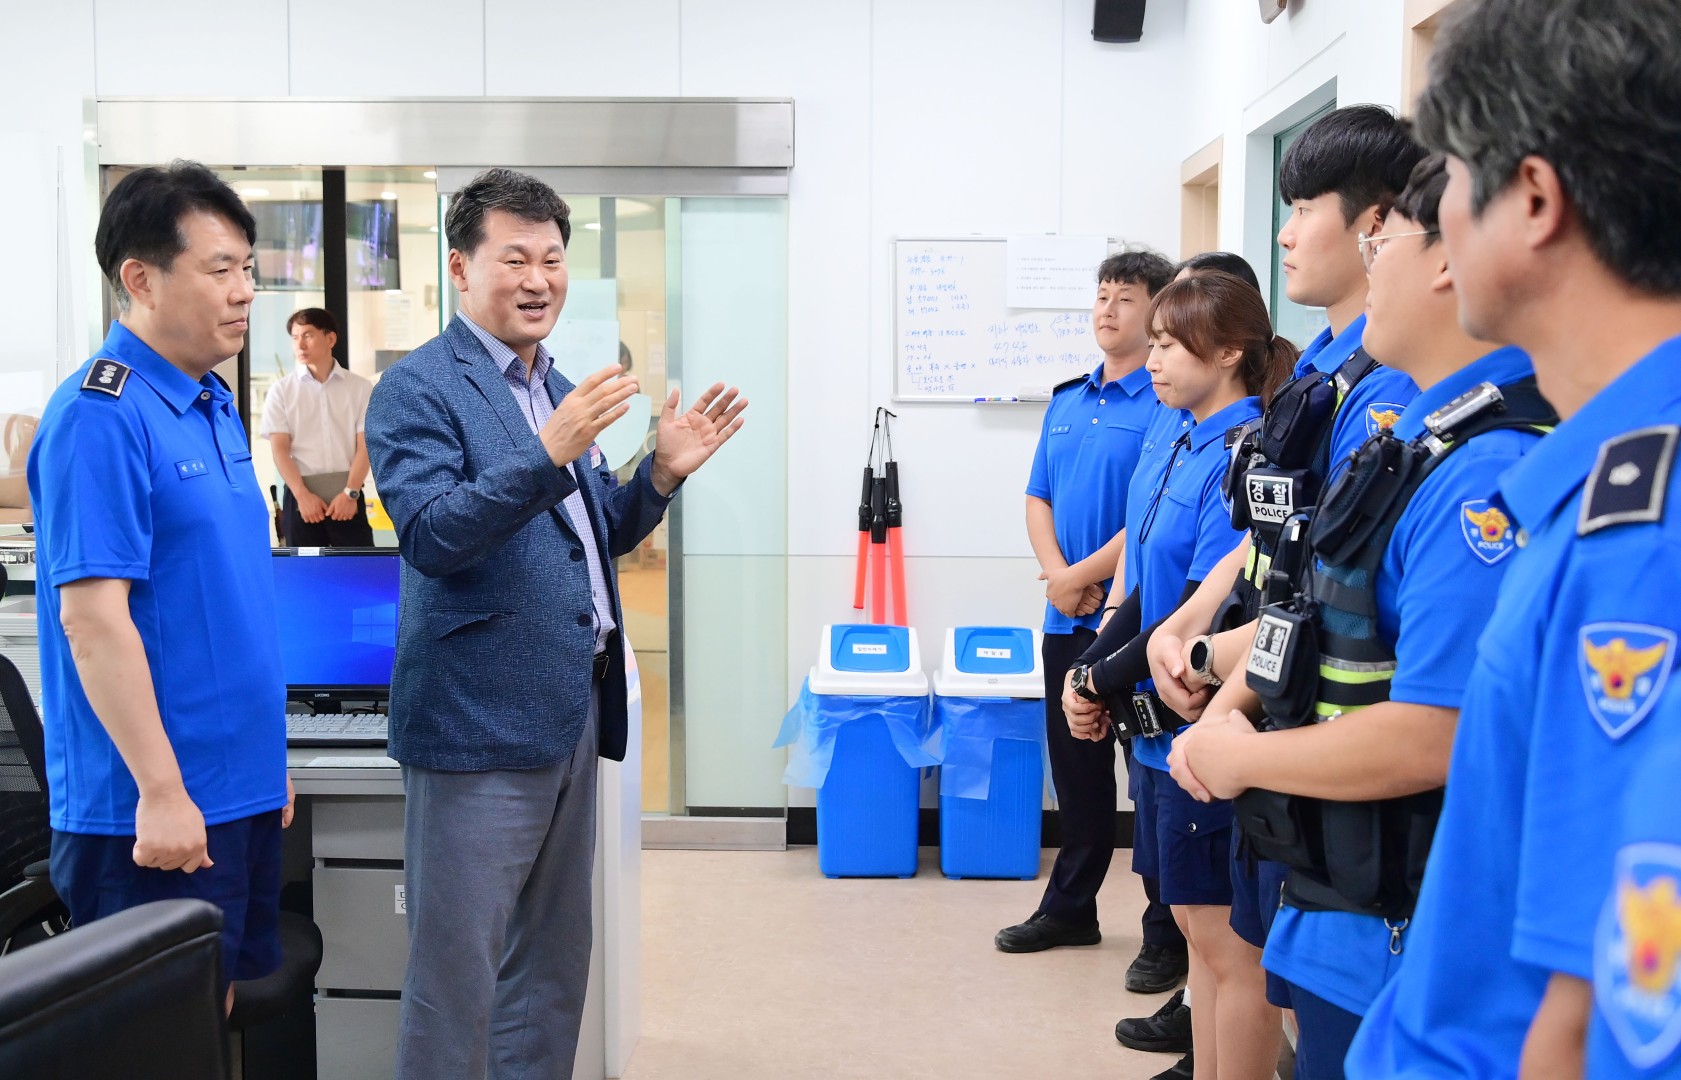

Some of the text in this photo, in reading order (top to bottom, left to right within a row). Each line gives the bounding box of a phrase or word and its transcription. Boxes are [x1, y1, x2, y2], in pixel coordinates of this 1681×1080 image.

[1251, 480, 1287, 505] 경찰
[1254, 506, 1288, 519] POLICE
[1257, 622, 1286, 656] 경찰
[1251, 654, 1277, 673] POLICE
